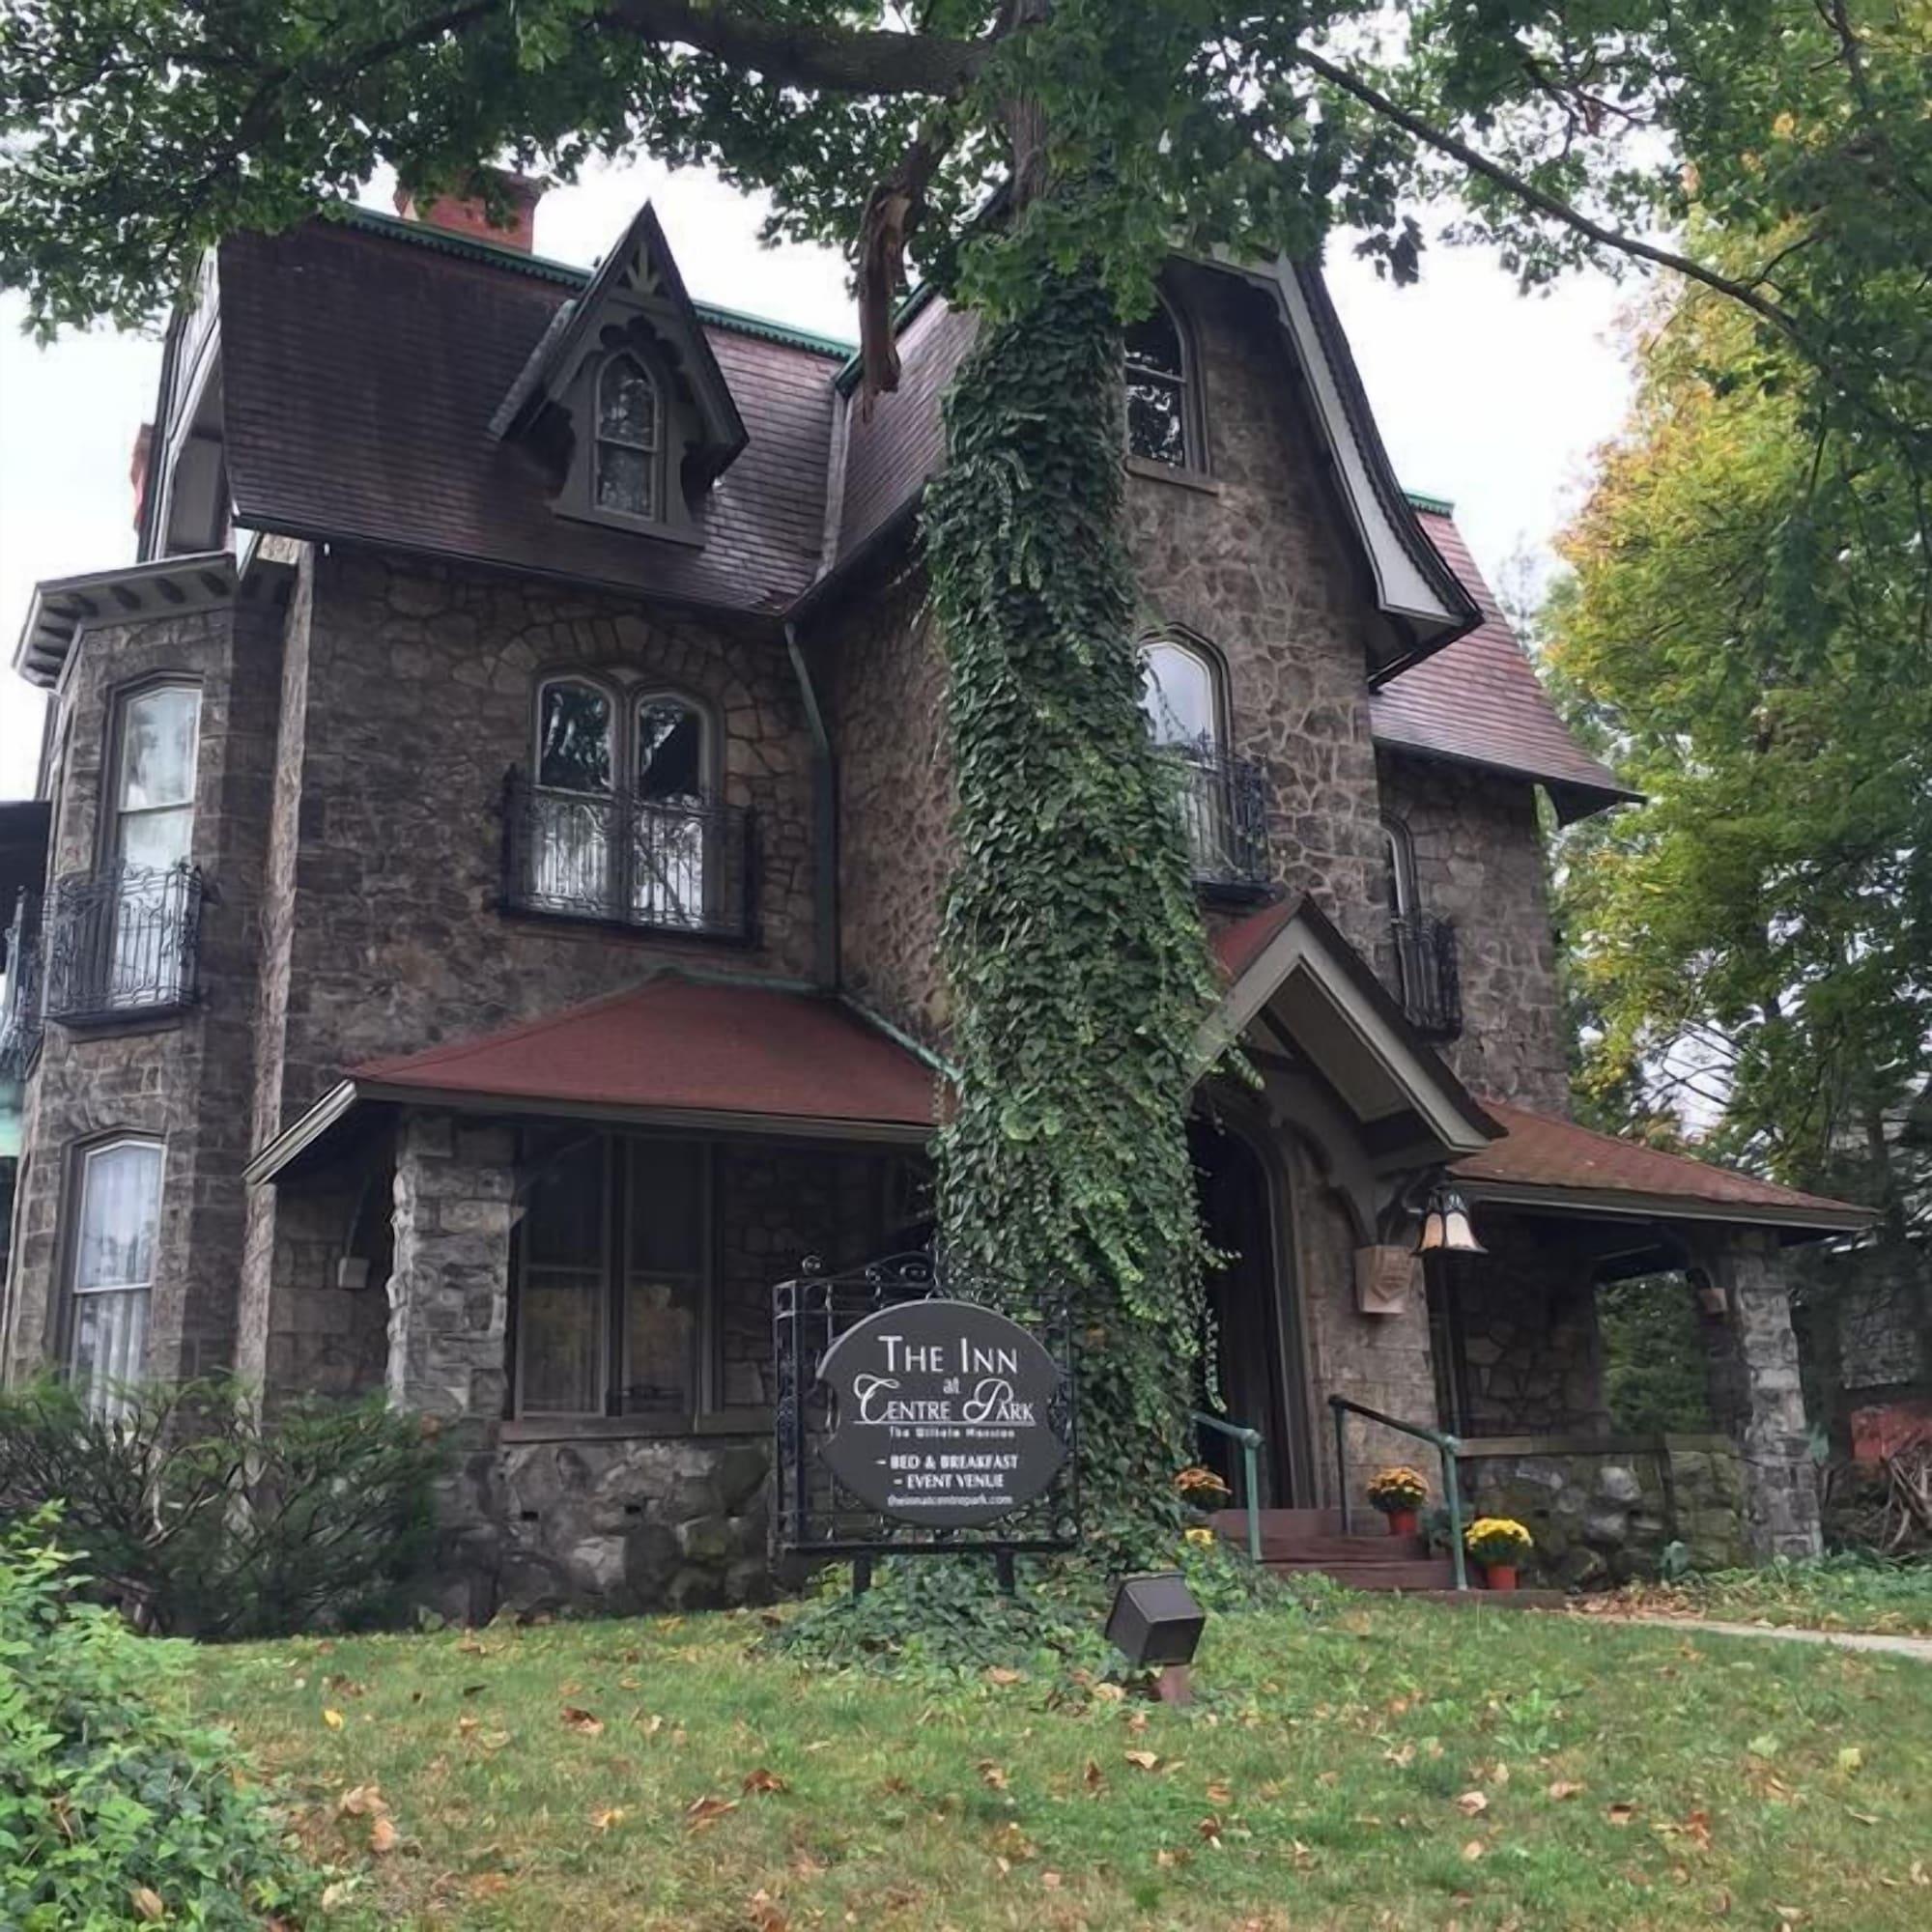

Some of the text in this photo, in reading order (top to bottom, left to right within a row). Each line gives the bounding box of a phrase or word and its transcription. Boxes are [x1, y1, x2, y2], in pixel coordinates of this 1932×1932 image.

[943, 1377, 959, 1394] at
[890, 1454, 920, 1469] BED
[923, 1455, 936, 1469] &
[940, 1454, 1017, 1469] BREAKFAST
[907, 1473, 952, 1489] EVENT
[955, 1472, 1004, 1488] VENUE
